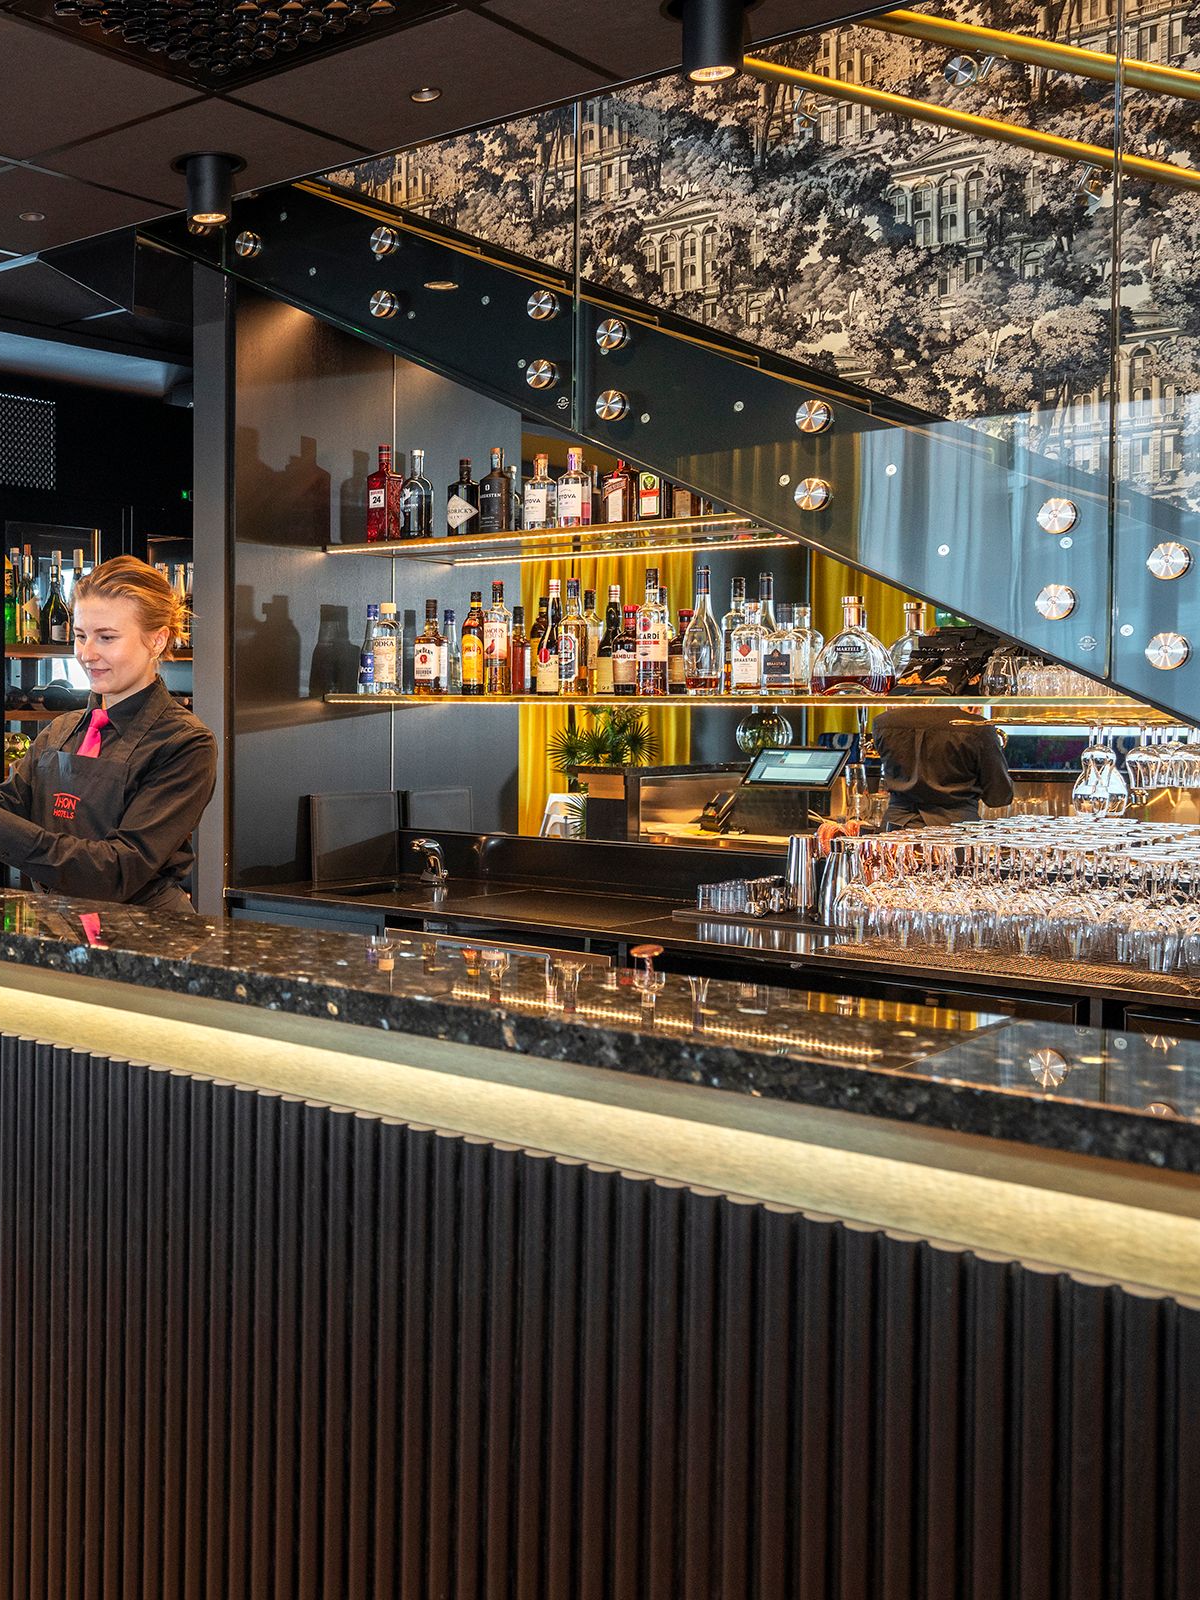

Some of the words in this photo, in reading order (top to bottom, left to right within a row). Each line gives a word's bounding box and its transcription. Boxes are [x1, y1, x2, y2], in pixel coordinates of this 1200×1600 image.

[372, 496, 381, 504] 24
[53, 793, 81, 810] THON
[53, 809, 75, 819] HOTELS
